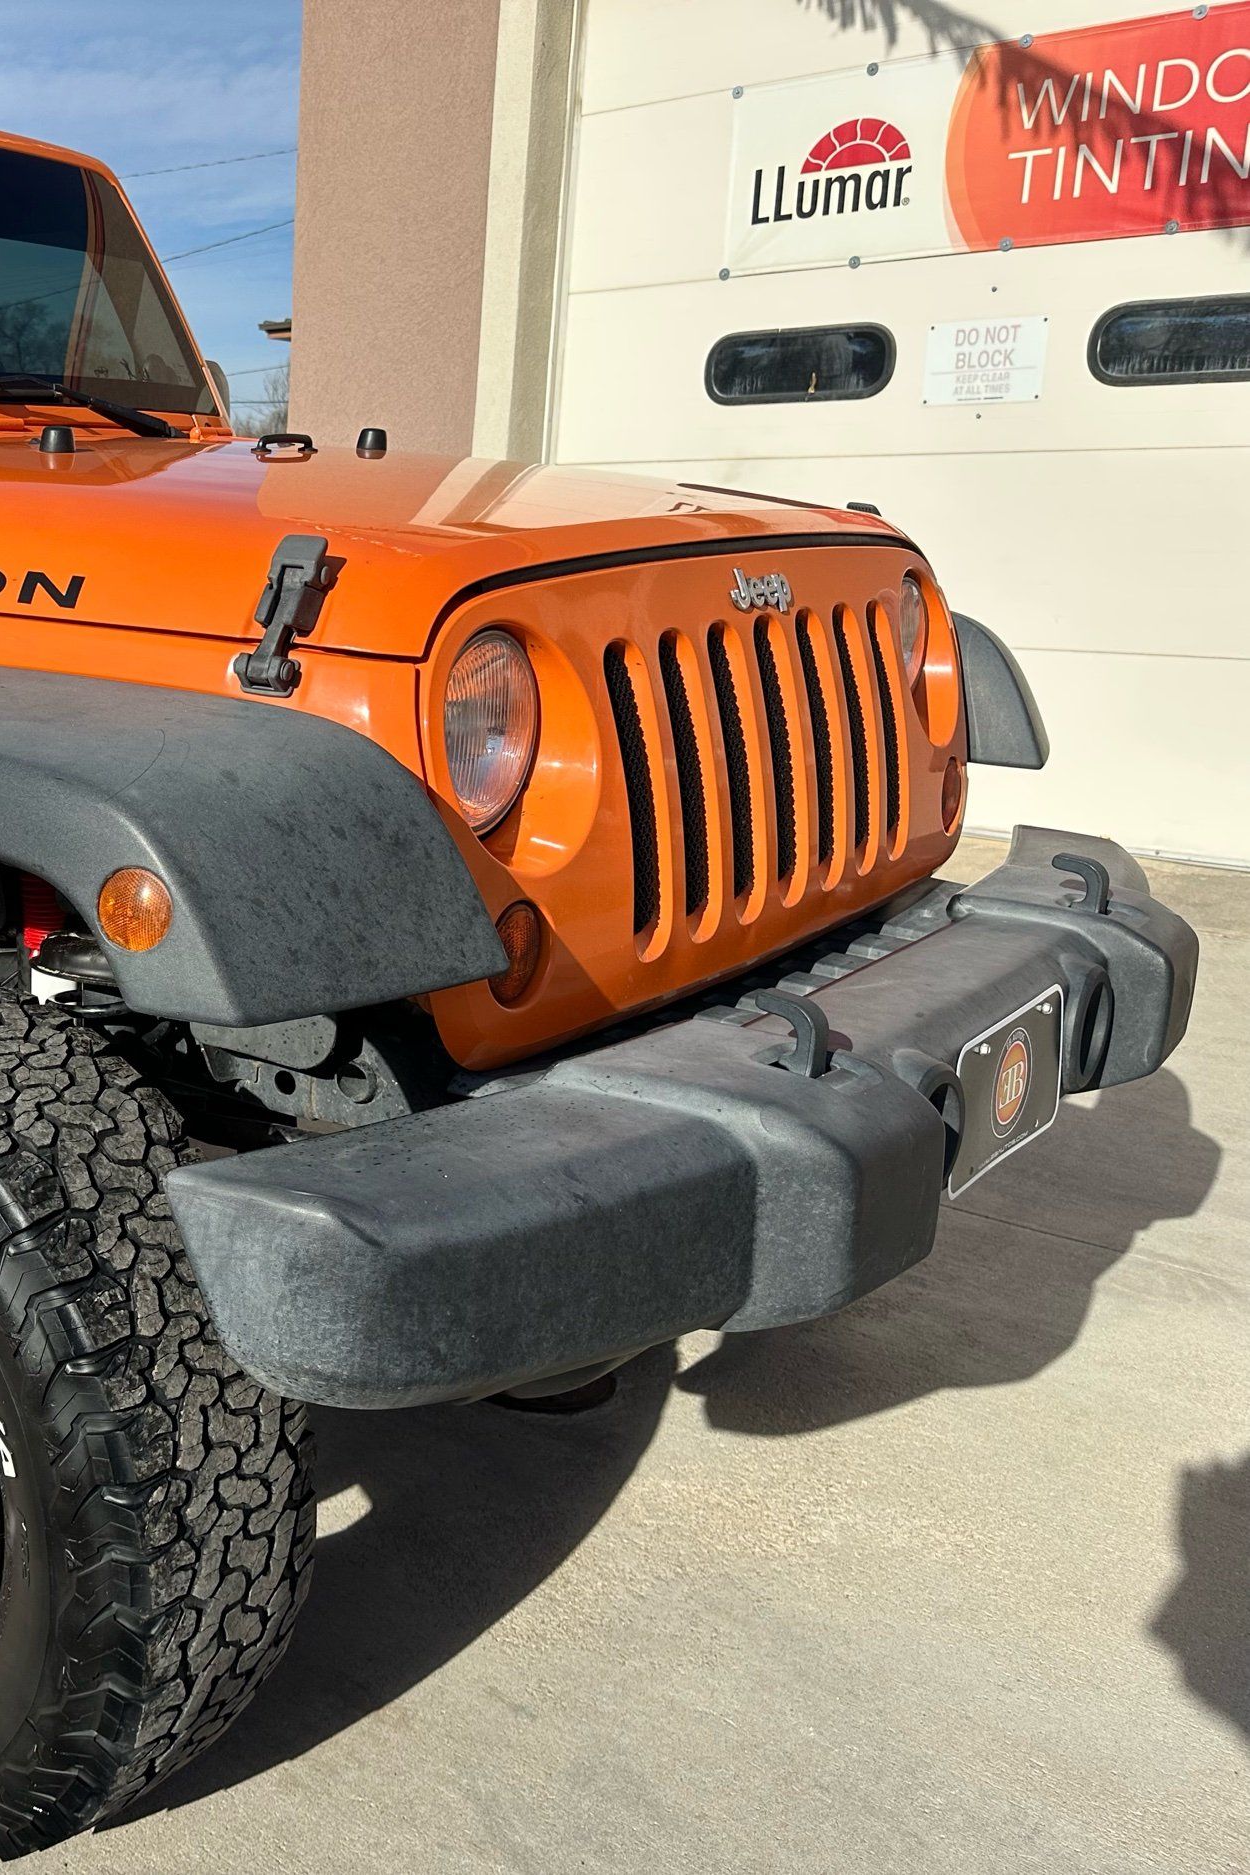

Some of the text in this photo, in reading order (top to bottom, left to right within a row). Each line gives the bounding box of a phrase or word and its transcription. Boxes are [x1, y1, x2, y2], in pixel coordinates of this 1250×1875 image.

[954, 324, 1021, 347] DO NOT
[954, 348, 1015, 370] BLOCK
[955, 371, 1011, 385] KEEP CLEAR
[953, 383, 1011, 396] AT ALL TIMES
[730, 567, 792, 613] Jeep
